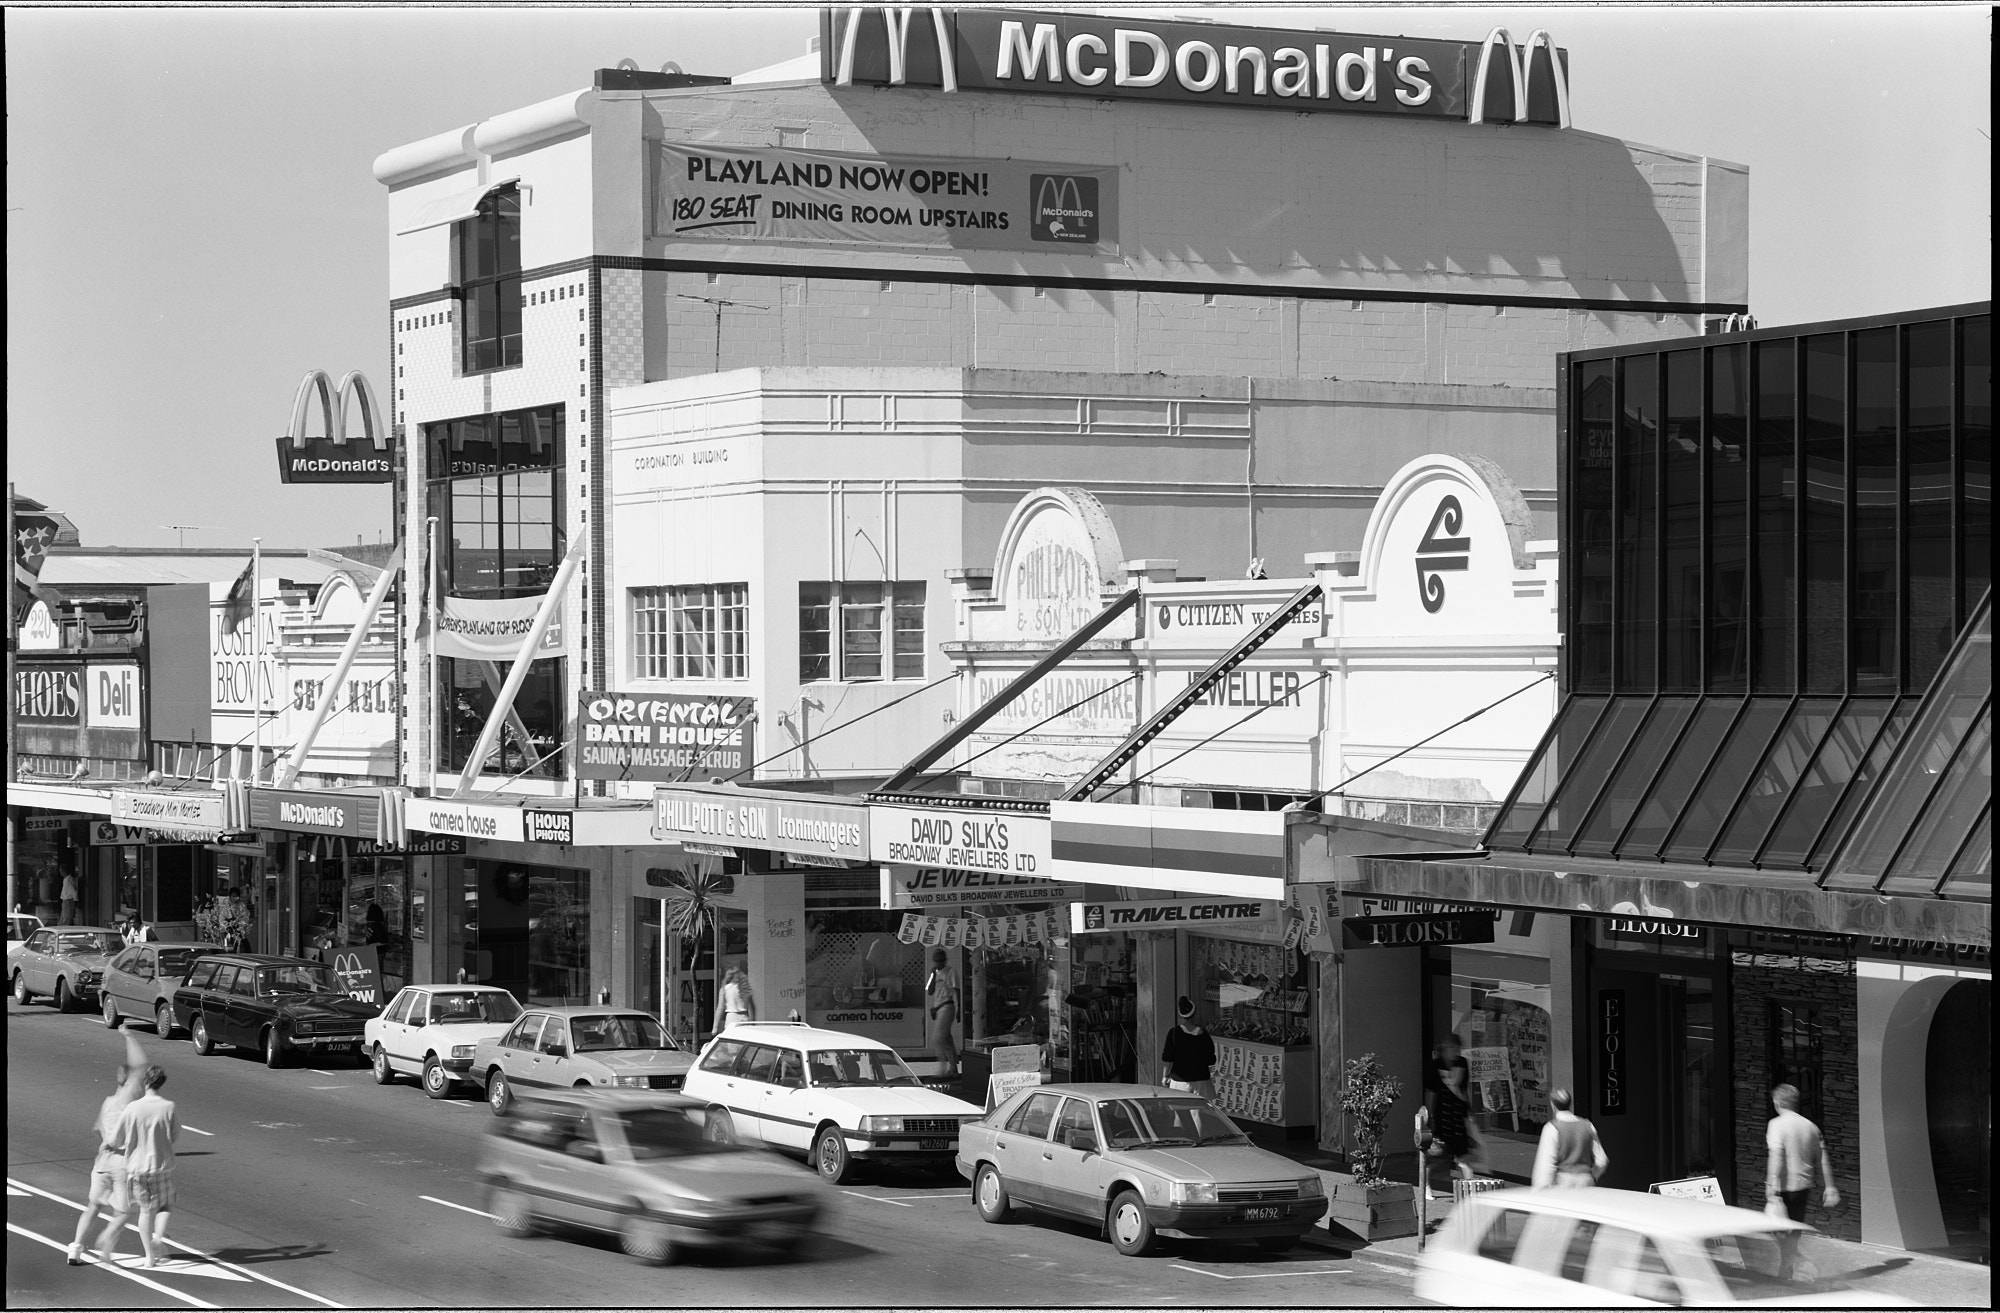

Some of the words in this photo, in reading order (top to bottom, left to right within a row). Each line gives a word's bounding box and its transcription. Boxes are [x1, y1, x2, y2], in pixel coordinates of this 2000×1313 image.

[997, 19, 1433, 107] McDonald's
[687, 157, 832, 189] PLAYLAND
[840, 165, 905, 193] NOW
[909, 170, 989, 197] OPEN!
[672, 197, 705, 222] 180
[709, 194, 761, 221] SEAT
[772, 201, 843, 223] DINING
[851, 205, 912, 226] ROOM
[918, 208, 1009, 230] UPSTAIRS
[1042, 207, 1094, 218] McDonald's
[292, 457, 390, 474] McDonald's
[634, 453, 684, 470] CORONATION
[692, 448, 729, 465] BUILDING
[31, 609, 52, 640] 220
[1035, 608, 1062, 631] SON
[1177, 604, 1244, 627] CITIZEN
[1252, 610, 1320, 625] WAHES
[99, 670, 131, 717] Deli
[294, 679, 338, 712] SE
[1044, 677, 1134, 720] HARDWARE
[588, 698, 737, 725] ORIENTAL
[586, 724, 651, 743] BATH
[659, 726, 743, 746] HOUSE
[583, 747, 626, 765] SAUNA
[280, 801, 345, 828] McDonald's
[430, 811, 464, 833] camera
[466, 806, 496, 836] house
[535, 813, 570, 830] HOUR
[657, 799, 724, 835] PHILLPOTT
[726, 809, 736, 836] &
[739, 806, 767, 840] SON
[777, 807, 861, 851] Ironmongers
[536, 829, 571, 842] PHOTOS
[911, 817, 953, 846] DAVID
[962, 816, 1009, 850] SILK'S
[889, 842, 942, 864] BROADWAY
[946, 848, 1009, 870] JEWELLERS
[1015, 853, 1037, 872] LTD
[906, 869, 1061, 890] JEWELL
[910, 894, 934, 904] DAVID
[960, 891, 1002, 901] BROADWAY
[1004, 889, 1048, 899] JEWELLERS
[1051, 888, 1065, 897] LTD
[1110, 906, 1187, 924] TRAVEL
[1189, 903, 1262, 920] CENTRE
[1369, 920, 1463, 945] ELOISE
[348, 990, 375, 1003] OW
[826, 1012, 867, 1022] camera
[870, 1008, 904, 1021] house
[1605, 999, 1621, 1107] ELOISE
[1247, 1207, 1279, 1219] MM6792
